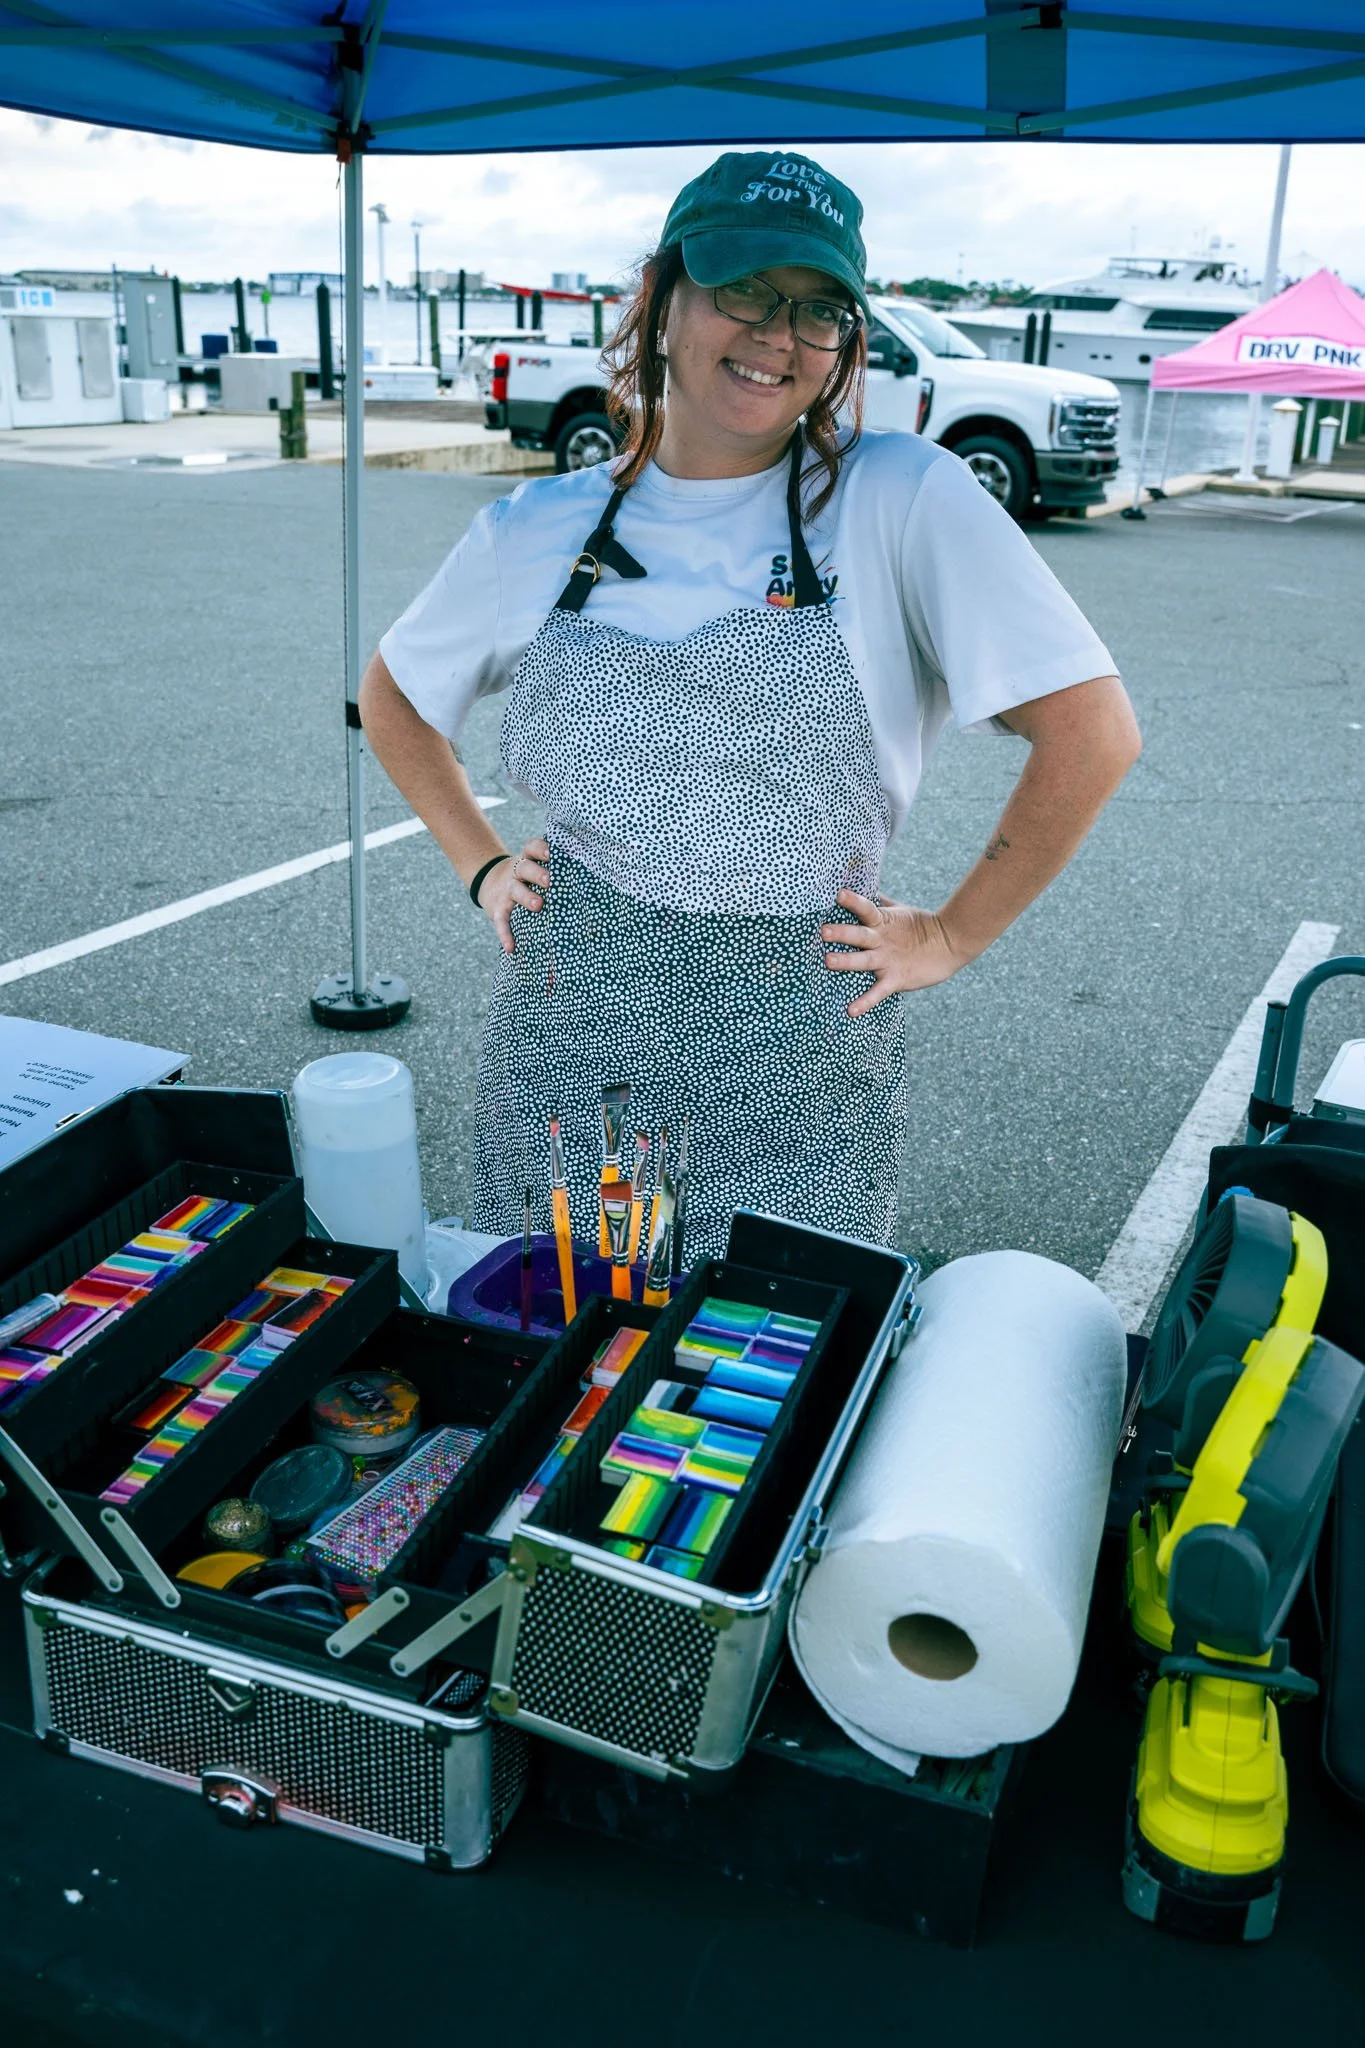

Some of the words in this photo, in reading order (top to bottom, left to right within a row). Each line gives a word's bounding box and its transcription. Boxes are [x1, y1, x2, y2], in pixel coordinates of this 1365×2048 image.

[765, 160, 827, 185] Love
[794, 178, 822, 193] That
[740, 181, 800, 202] For
[807, 190, 844, 227] You
[1249, 343, 1300, 359] DRV
[1313, 344, 1362, 367] PNK
[56, 1075, 88, 1085] placed
[61, 1069, 95, 1080] instead
[13, 1094, 51, 1109] Unicorn
